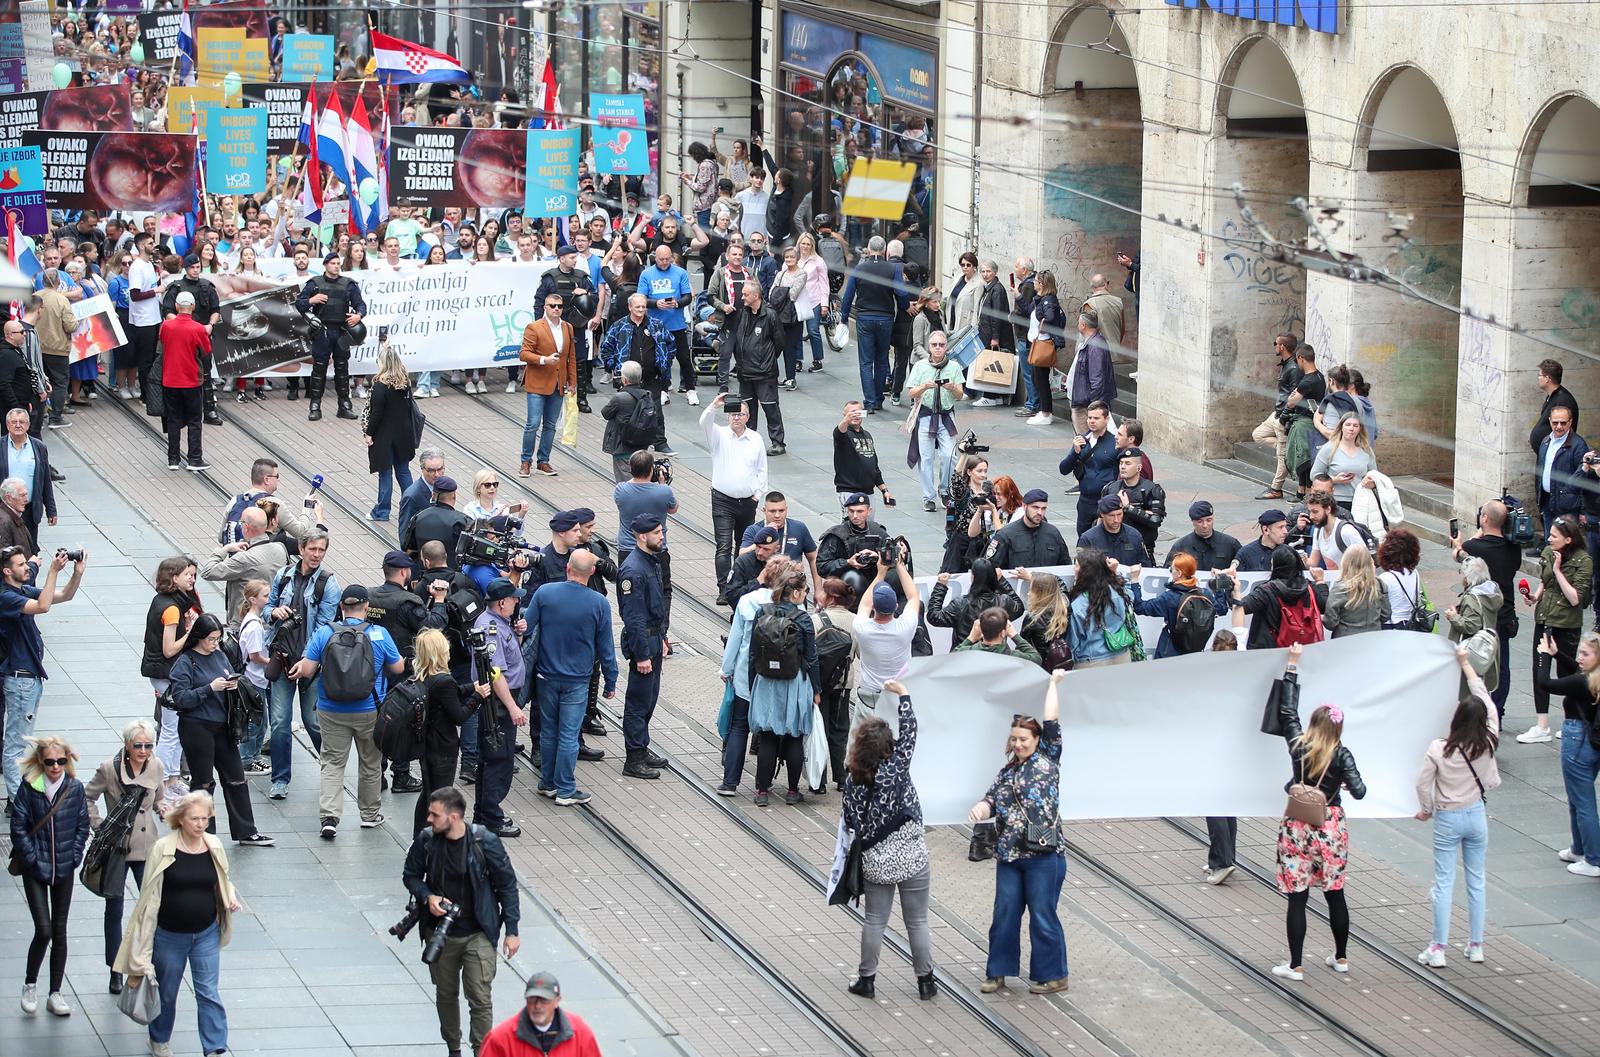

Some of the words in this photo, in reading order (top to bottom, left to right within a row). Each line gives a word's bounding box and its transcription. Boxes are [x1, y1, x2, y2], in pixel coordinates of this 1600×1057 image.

[157, 14, 182, 27] OVAK
[146, 25, 180, 39] IZGLEDA
[265, 88, 302, 101] OVAKO
[3, 98, 38, 113] OVAKO
[0, 111, 39, 126] GLEDAM
[269, 114, 302, 127] DESET
[225, 129, 252, 141] LIVES
[415, 133, 454, 148] OVAKO
[47, 138, 88, 151] OVAKO
[11, 150, 36, 161] IZBOR
[41, 152, 87, 166] GLEDAM
[397, 147, 454, 162] IZGLEDAM
[545, 152, 569, 163] LIVES
[229, 157, 248, 168] TOO
[408, 162, 416, 176] S
[418, 162, 454, 176] DESET
[49, 166, 86, 180] DESET
[44, 180, 85, 193] EDANA
[404, 176, 453, 191] TJEDANA
[14, 193, 42, 206] DIJETE
[377, 271, 468, 296] zaustavljaj
[368, 296, 421, 318] kucaje
[425, 296, 470, 314] moga
[474, 290, 514, 309] srca!
[403, 316, 430, 337] daj
[435, 314, 457, 332] mi
[490, 309, 534, 338] HO
